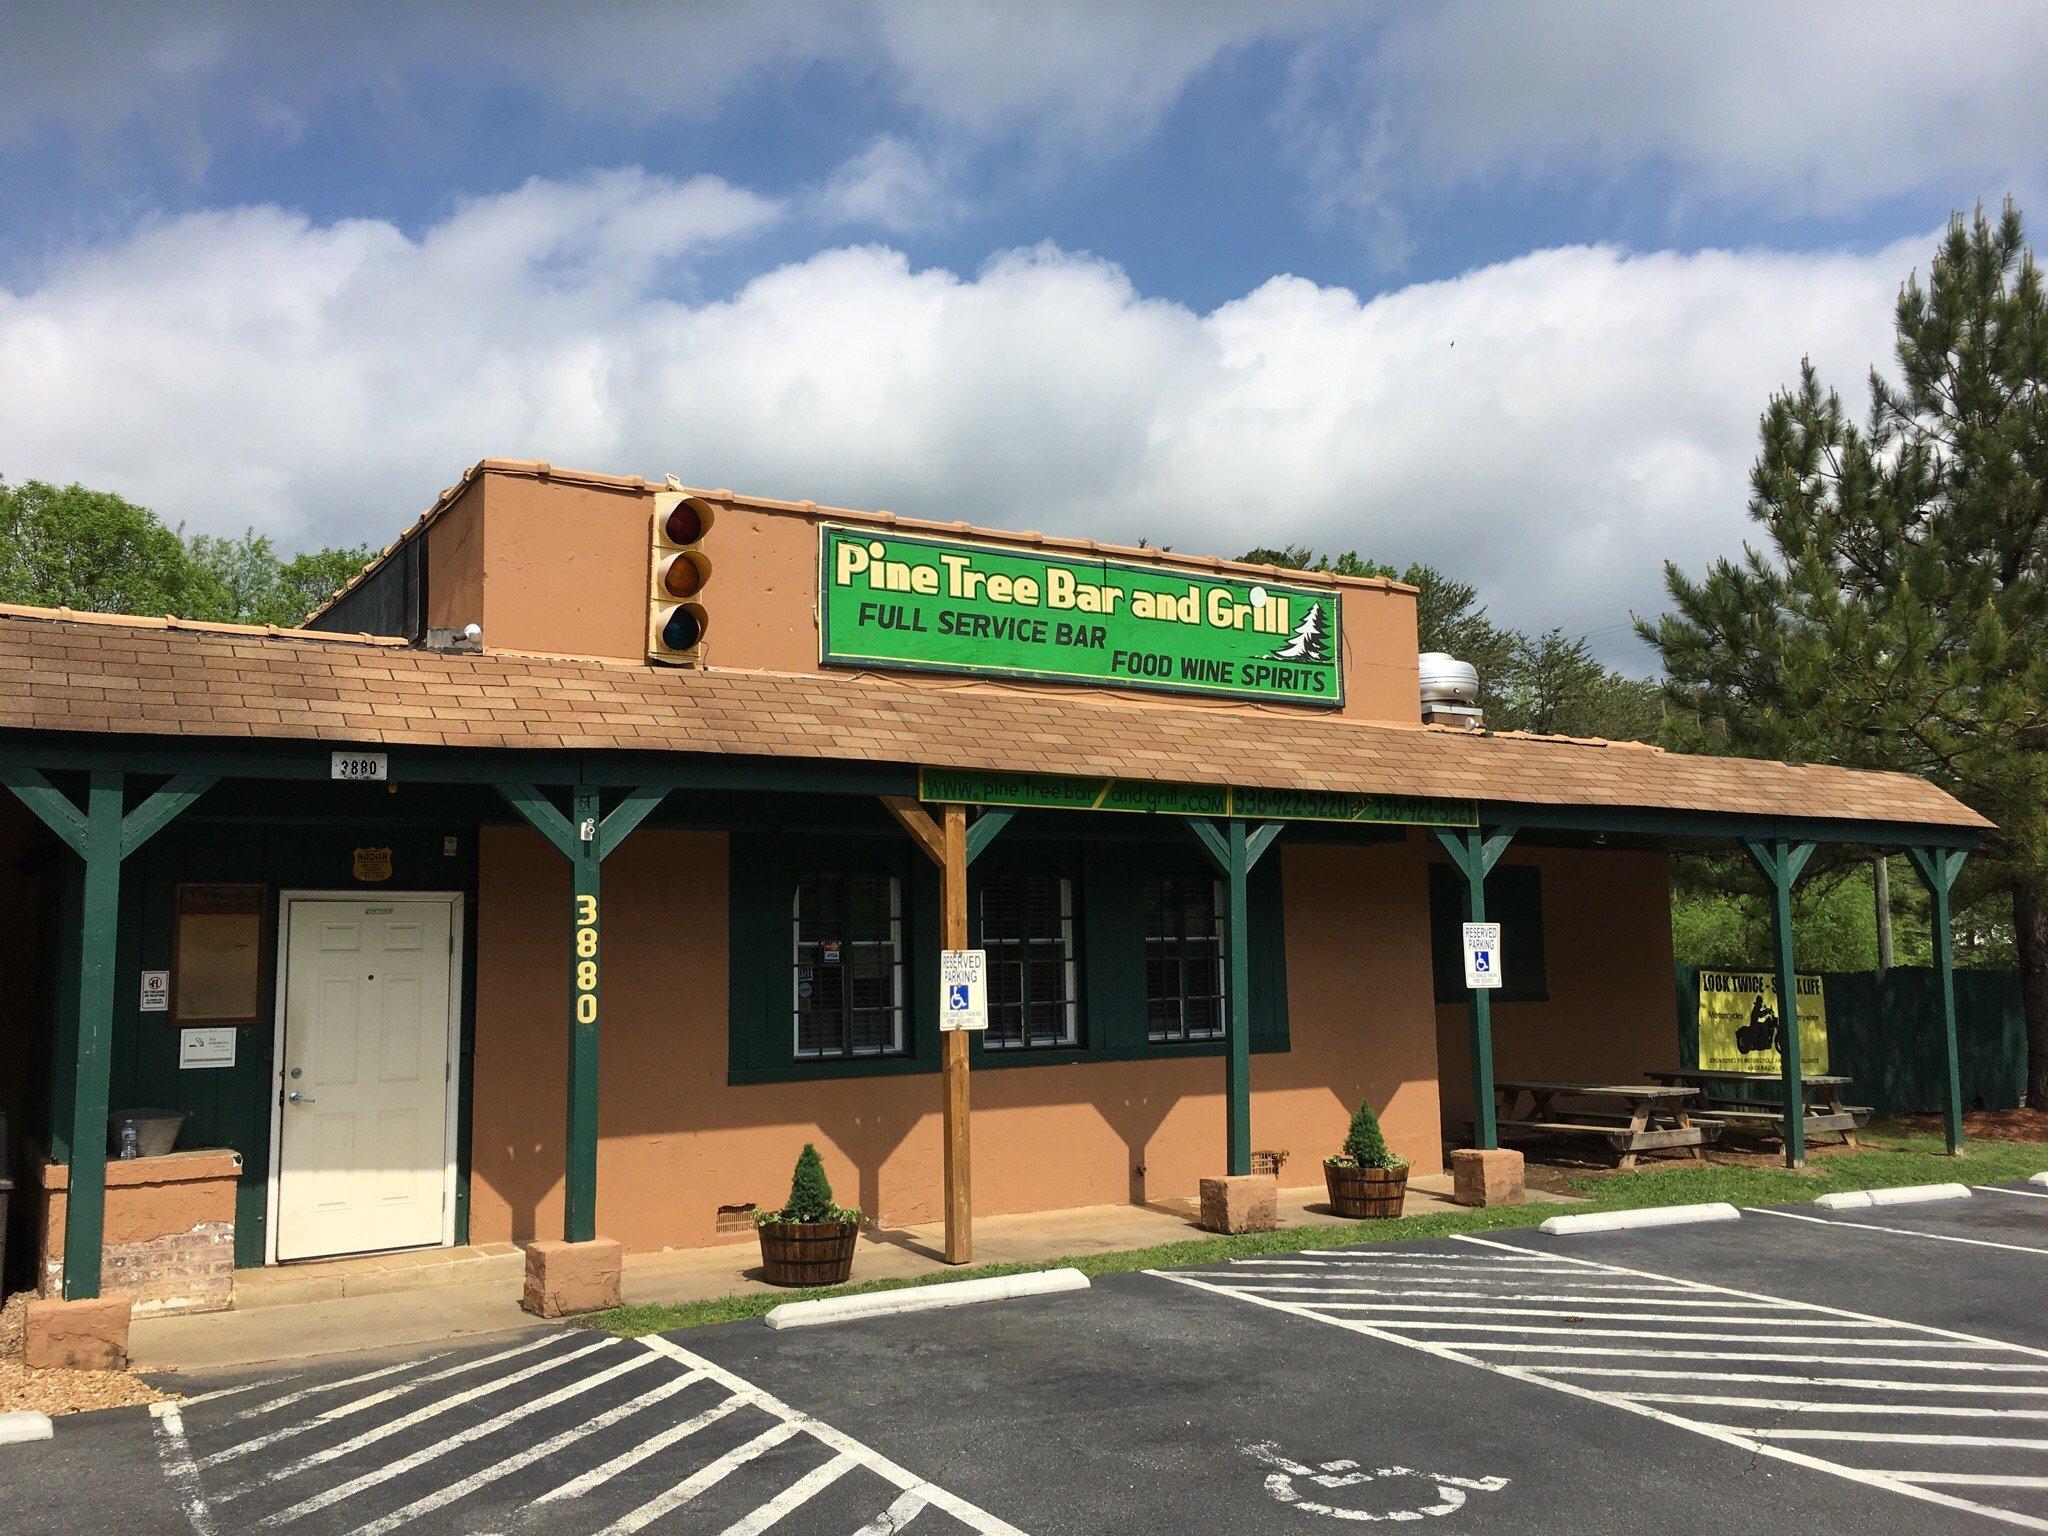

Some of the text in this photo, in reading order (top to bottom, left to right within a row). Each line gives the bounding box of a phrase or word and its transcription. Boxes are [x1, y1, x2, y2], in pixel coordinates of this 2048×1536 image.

[835, 540, 1292, 637] Pine Tree Bar and Grill
[858, 603, 1107, 650] FULL SERVICE BAR
[1111, 651, 1326, 693] FOOD WINE SPIRITS
[983, 780, 1018, 801] pine
[1023, 780, 1062, 800] tree
[1064, 782, 1093, 801] bar
[1111, 783, 1144, 804] and
[1146, 787, 1179, 813] grill
[1466, 928, 1496, 938] RESERVED
[1469, 940, 1494, 950] PARKING
[576, 894, 598, 1024] 3880
[943, 956, 981, 969] RESERVED
[945, 970, 977, 983] PARKING
[1702, 974, 1730, 992] LOOK
[1732, 976, 1764, 993] TWICE
[1707, 1011, 1743, 1022] Motorcycles
